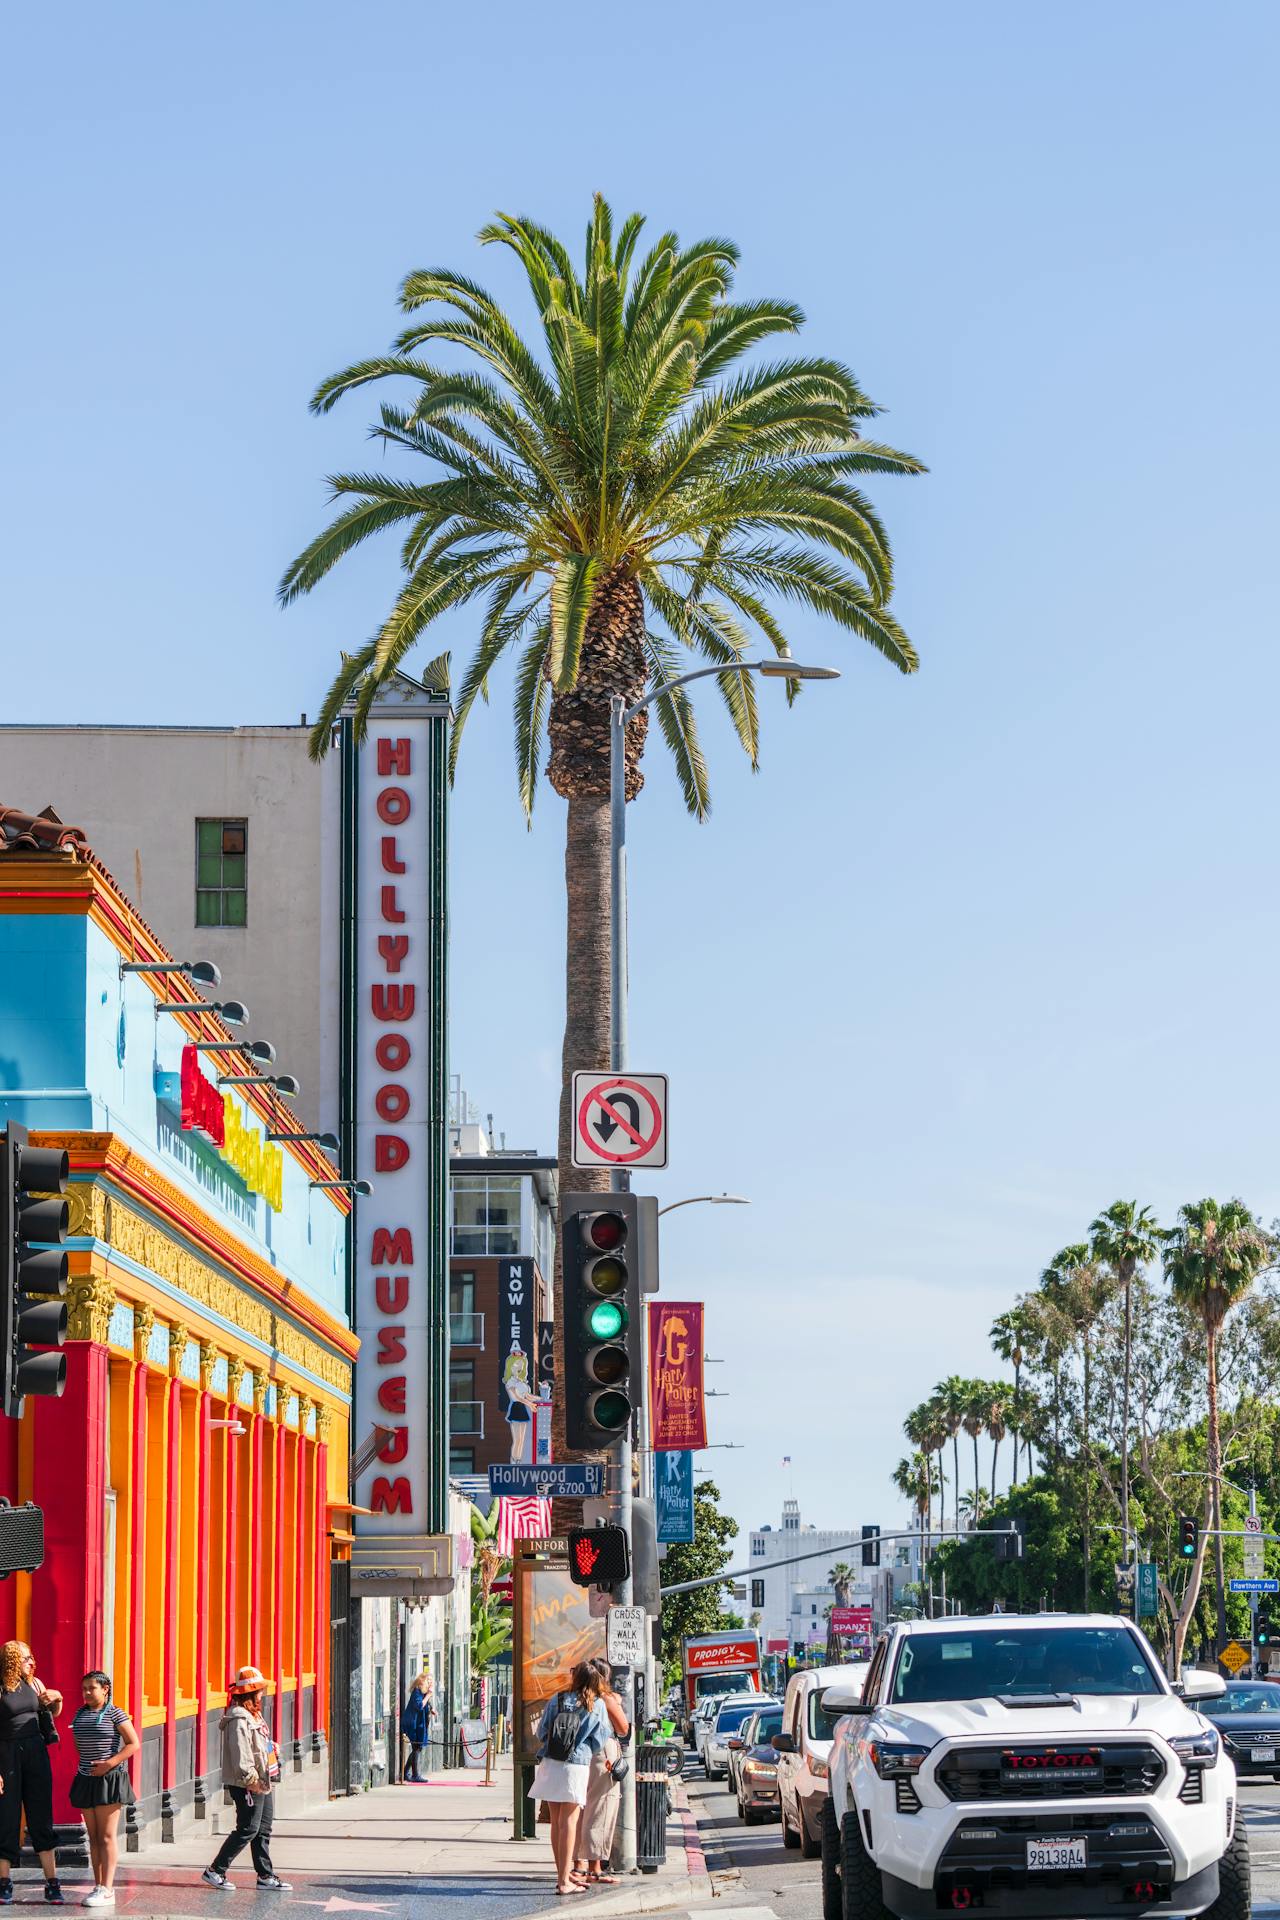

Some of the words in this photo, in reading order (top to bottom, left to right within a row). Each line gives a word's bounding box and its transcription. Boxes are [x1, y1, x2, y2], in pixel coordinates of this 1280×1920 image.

[371, 738, 415, 1173] HOLLYWOOD
[507, 1266, 524, 1306] NOW
[371, 1227, 413, 1515] MUSEUM
[655, 1368, 686, 1390] Harry
[665, 1383, 698, 1406] Potter
[658, 1419, 698, 1427] ENGAGEMENT
[493, 1466, 566, 1487] Hollywood
[585, 1466, 599, 1483] Bl
[559, 1483, 585, 1494] 6700
[591, 1483, 599, 1494] W
[659, 1485, 681, 1500] Harry
[667, 1497, 689, 1510] Potter
[1233, 1582, 1262, 1590] Hawthorn
[1264, 1582, 1275, 1590] Ave
[614, 1610, 641, 1619] CROSS
[622, 1621, 632, 1629] ON
[833, 1623, 866, 1631] SPANX
[617, 1630, 637, 1639] WALK
[694, 1645, 736, 1662] PRODIGY
[1009, 1755, 1095, 1768] TOYOTA
[1030, 1849, 1083, 1866] 98138A4
